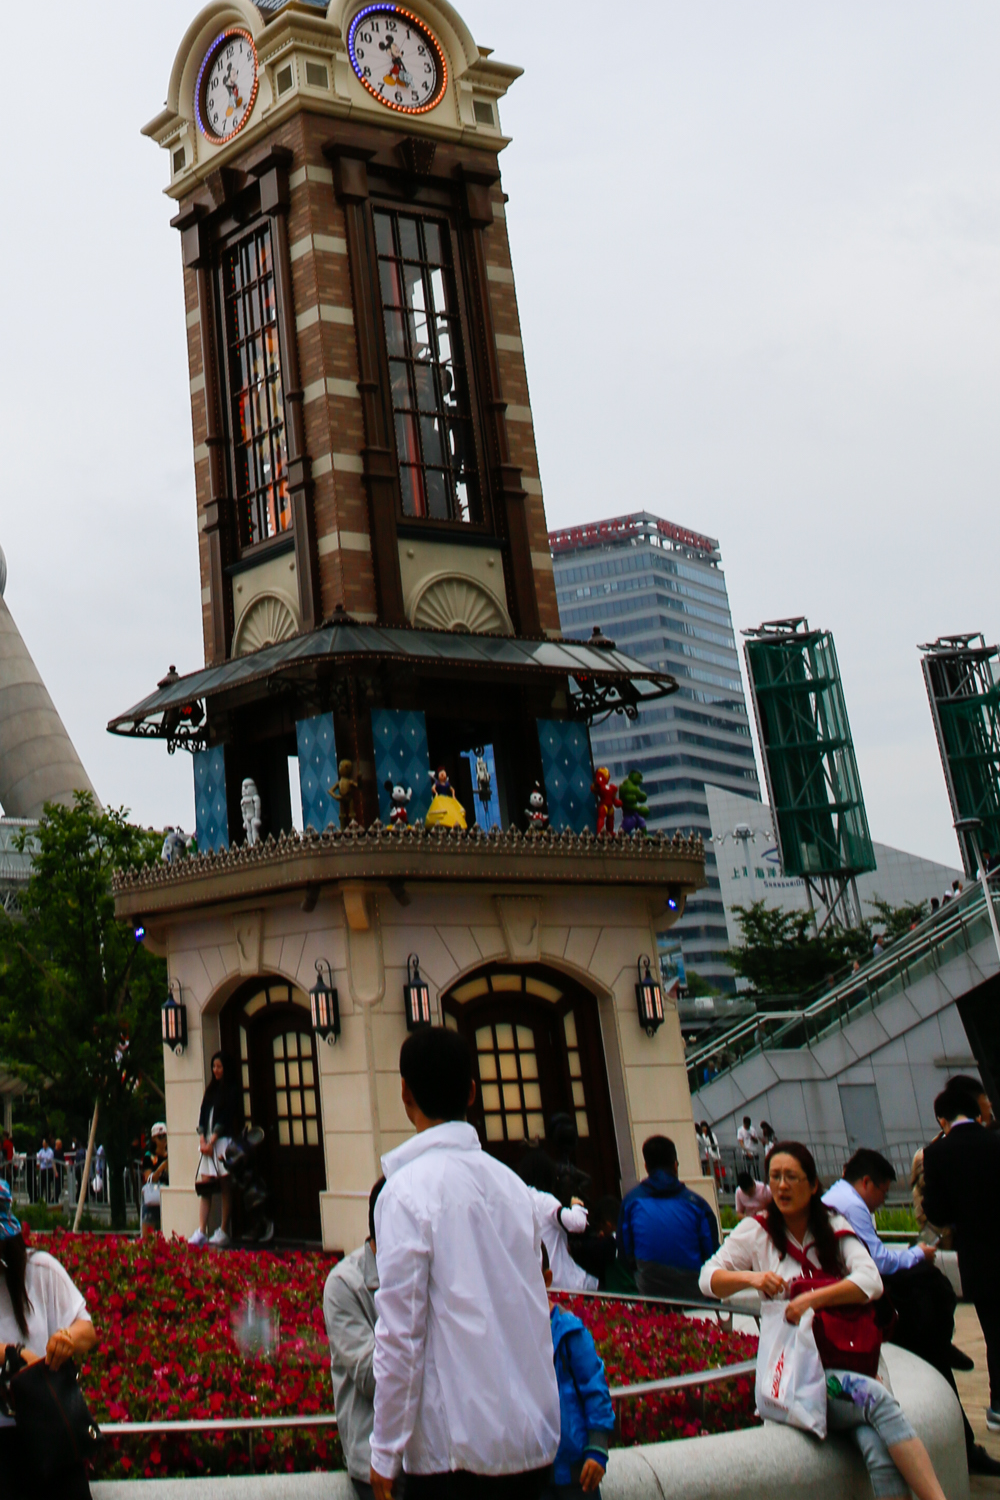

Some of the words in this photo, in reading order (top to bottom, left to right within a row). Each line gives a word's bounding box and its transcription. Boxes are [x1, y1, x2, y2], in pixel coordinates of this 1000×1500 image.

[371, 21, 379, 33] 11
[385, 20, 397, 32] 12
[360, 31, 372, 44] 10
[406, 30, 411, 40] 1
[226, 46, 234, 60] 12
[239, 43, 243, 53] 1
[356, 48, 364, 59] 9
[417, 45, 426, 57] 2
[247, 50, 252, 62] 2
[217, 59, 223, 72] 11
[424, 62, 431, 73] 3
[363, 66, 371, 77] 8
[210, 77, 219, 91] 10
[378, 82, 385, 93] 7
[421, 81, 429, 91] 4
[395, 91, 402, 102] 6
[411, 90, 419, 101] 5
[209, 99, 214, 110] 9
[213, 112, 218, 124] 8
[232, 116, 238, 128] 6
